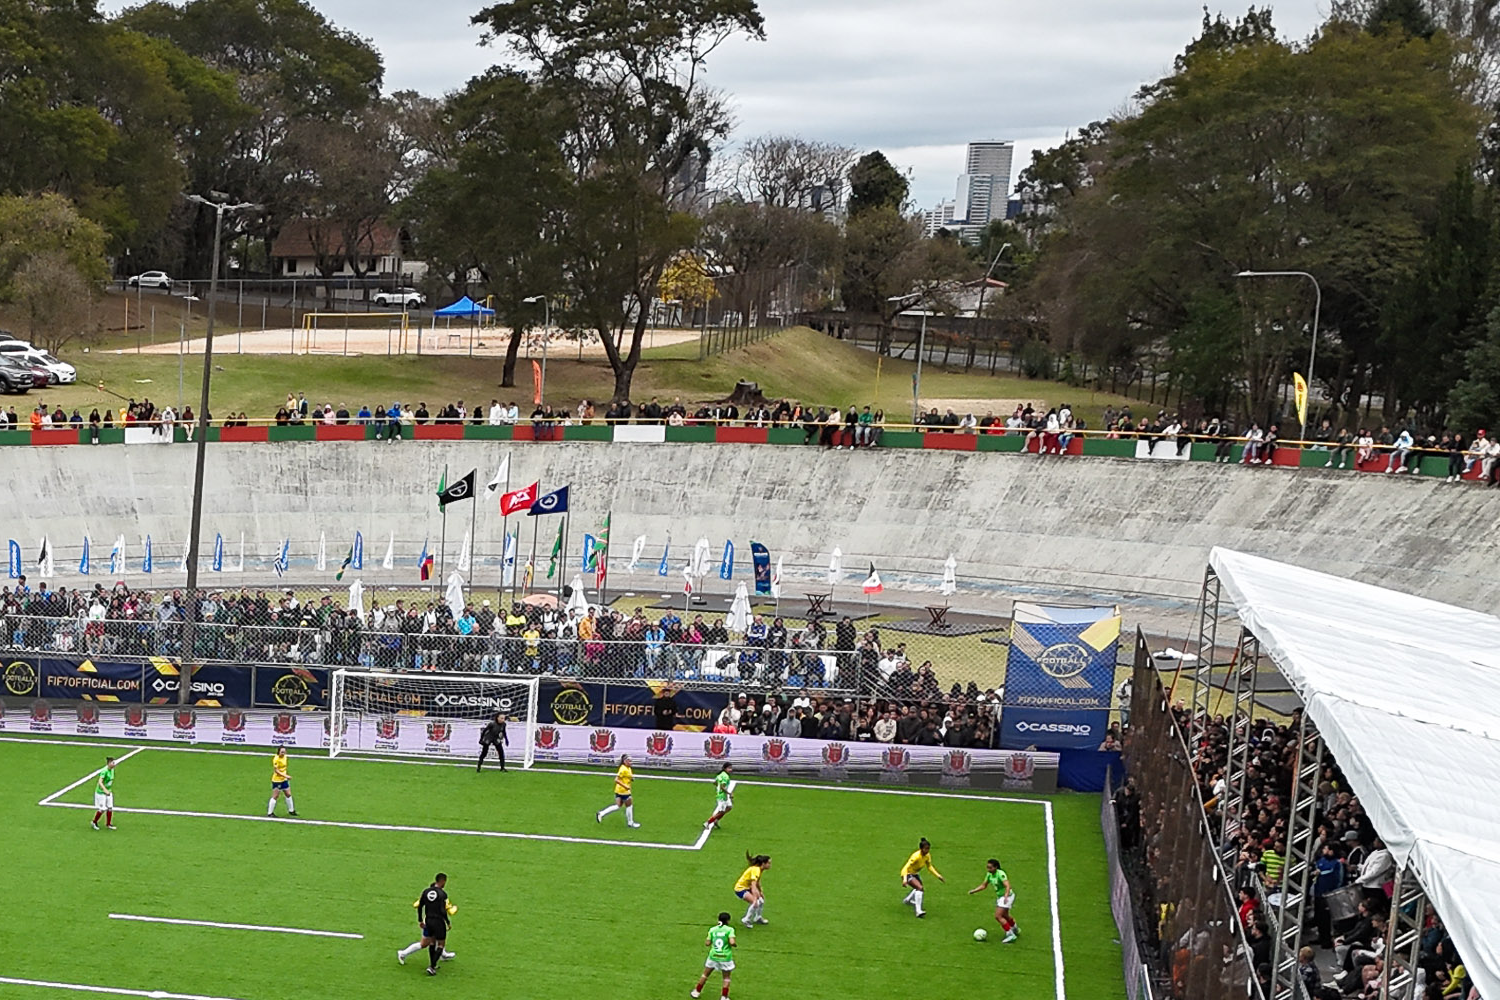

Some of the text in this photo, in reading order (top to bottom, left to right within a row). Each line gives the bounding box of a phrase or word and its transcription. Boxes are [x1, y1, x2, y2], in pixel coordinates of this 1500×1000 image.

[47, 675, 140, 690] FIF7OFFICIAL.COM
[165, 681, 224, 693] CASINO
[449, 694, 512, 708] CASSINO
[550, 703, 586, 712] FOOTBALL
[1029, 723, 1091, 733] CASSINO
